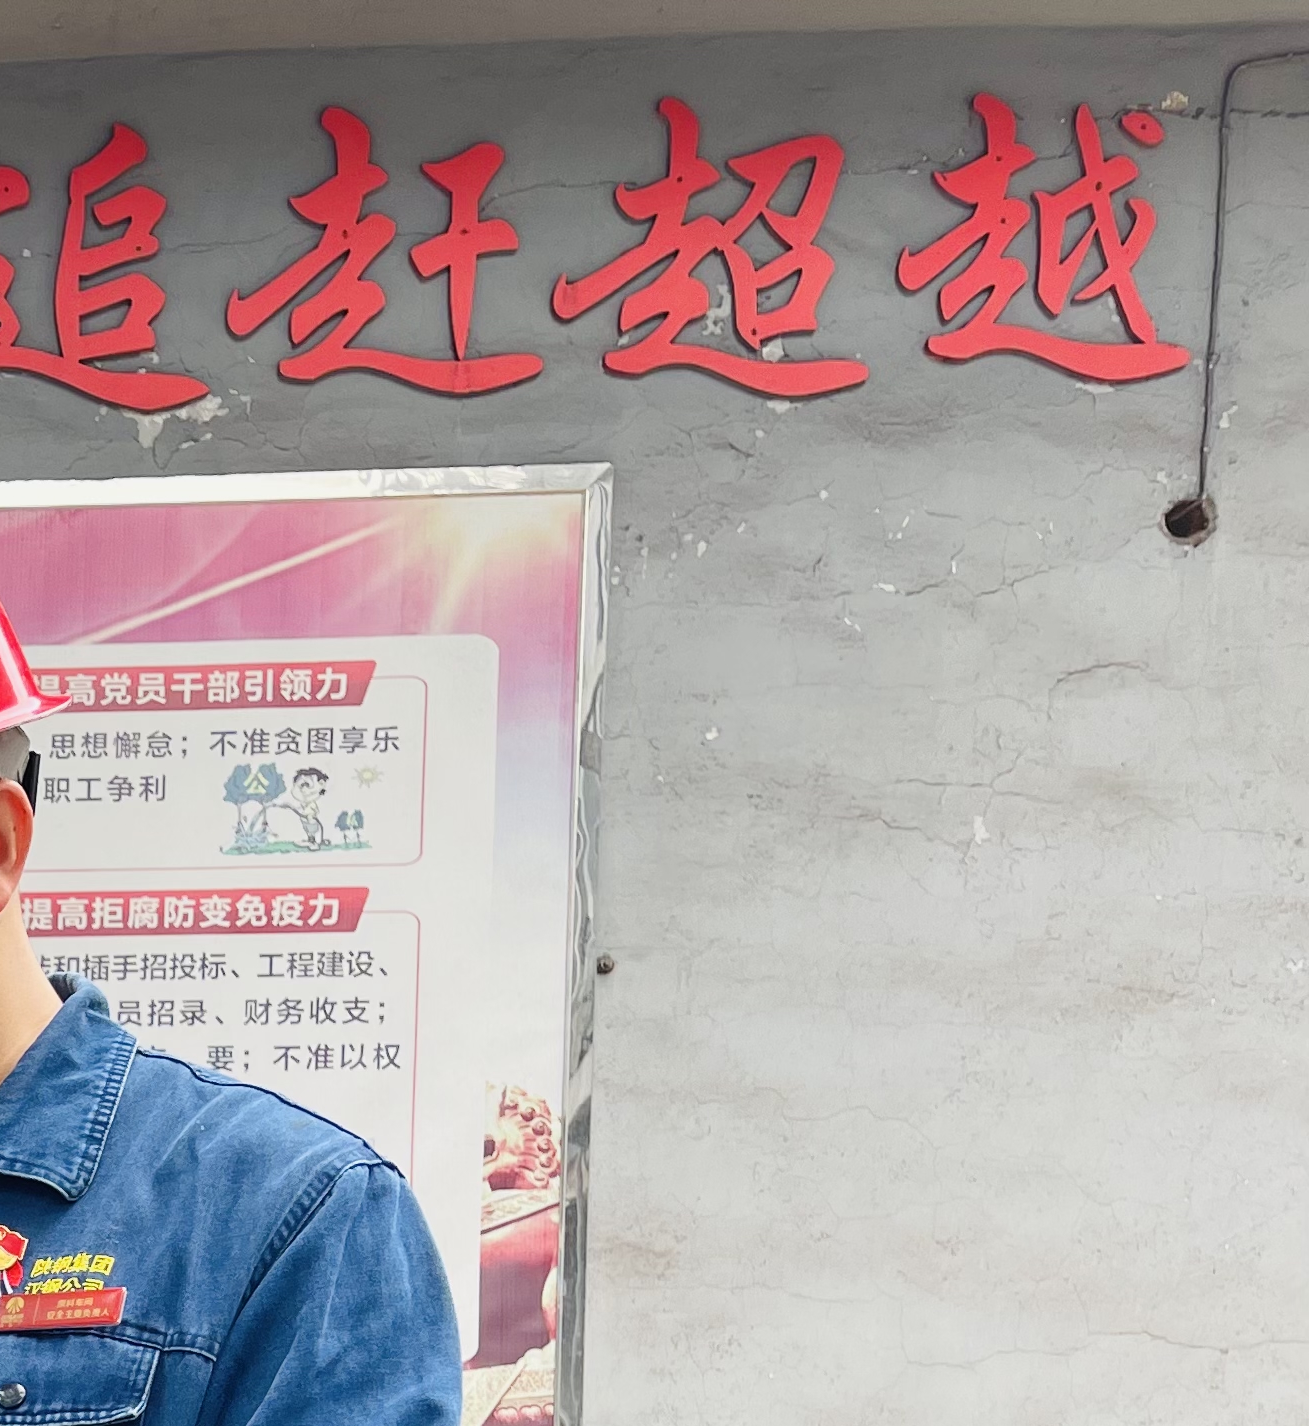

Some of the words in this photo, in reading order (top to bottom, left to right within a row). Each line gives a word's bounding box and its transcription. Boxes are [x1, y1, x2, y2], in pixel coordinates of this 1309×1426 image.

[49, 725, 400, 760] 思想懈怠；不准贪图享乐
[43, 774, 167, 804] 职工争利
[21, 892, 340, 932] 提高拒腐防变免疫力
[117, 996, 386, 1027] 员招录、财务收支；
[206, 1043, 401, 1073] 要；不准以权
[30, 1252, 115, 1277] 陕钢集团
